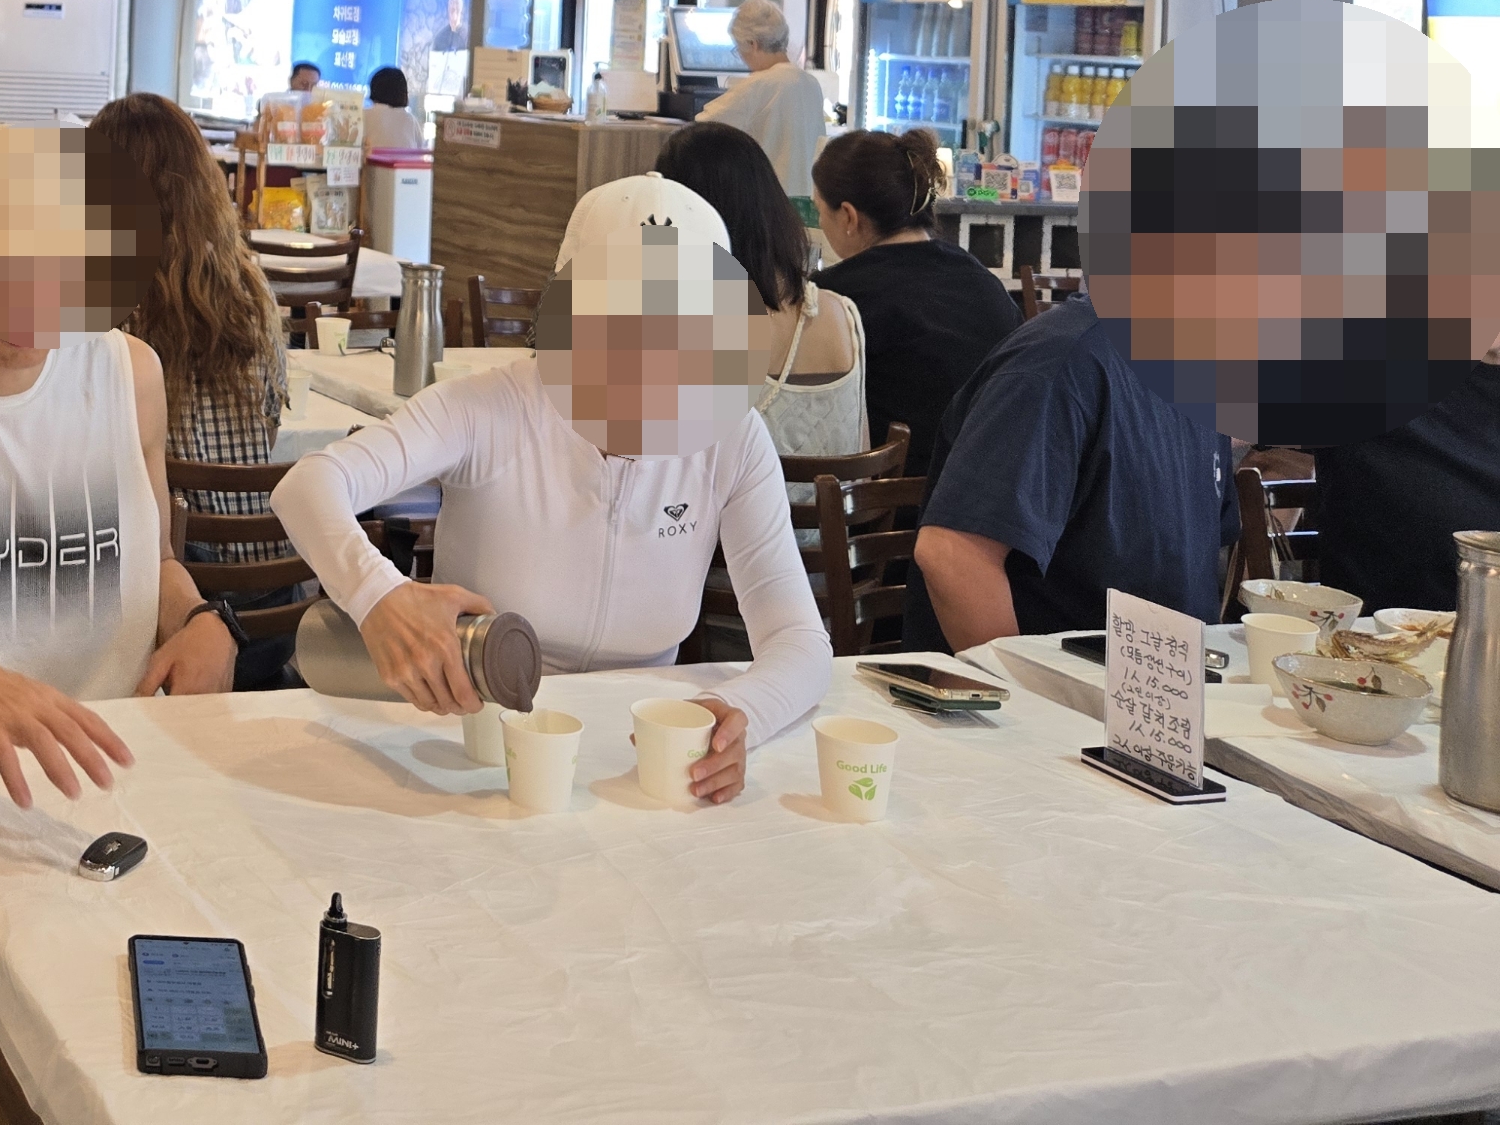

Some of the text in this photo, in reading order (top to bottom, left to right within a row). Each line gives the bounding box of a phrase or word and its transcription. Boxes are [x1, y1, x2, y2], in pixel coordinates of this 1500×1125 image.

[658, 521, 698, 538] ROXY
[1165, 635, 1189, 662] 정식
[1139, 701, 1165, 728] 갈치
[1167, 715, 1191, 740] 조림
[836, 759, 888, 775] Good Life
